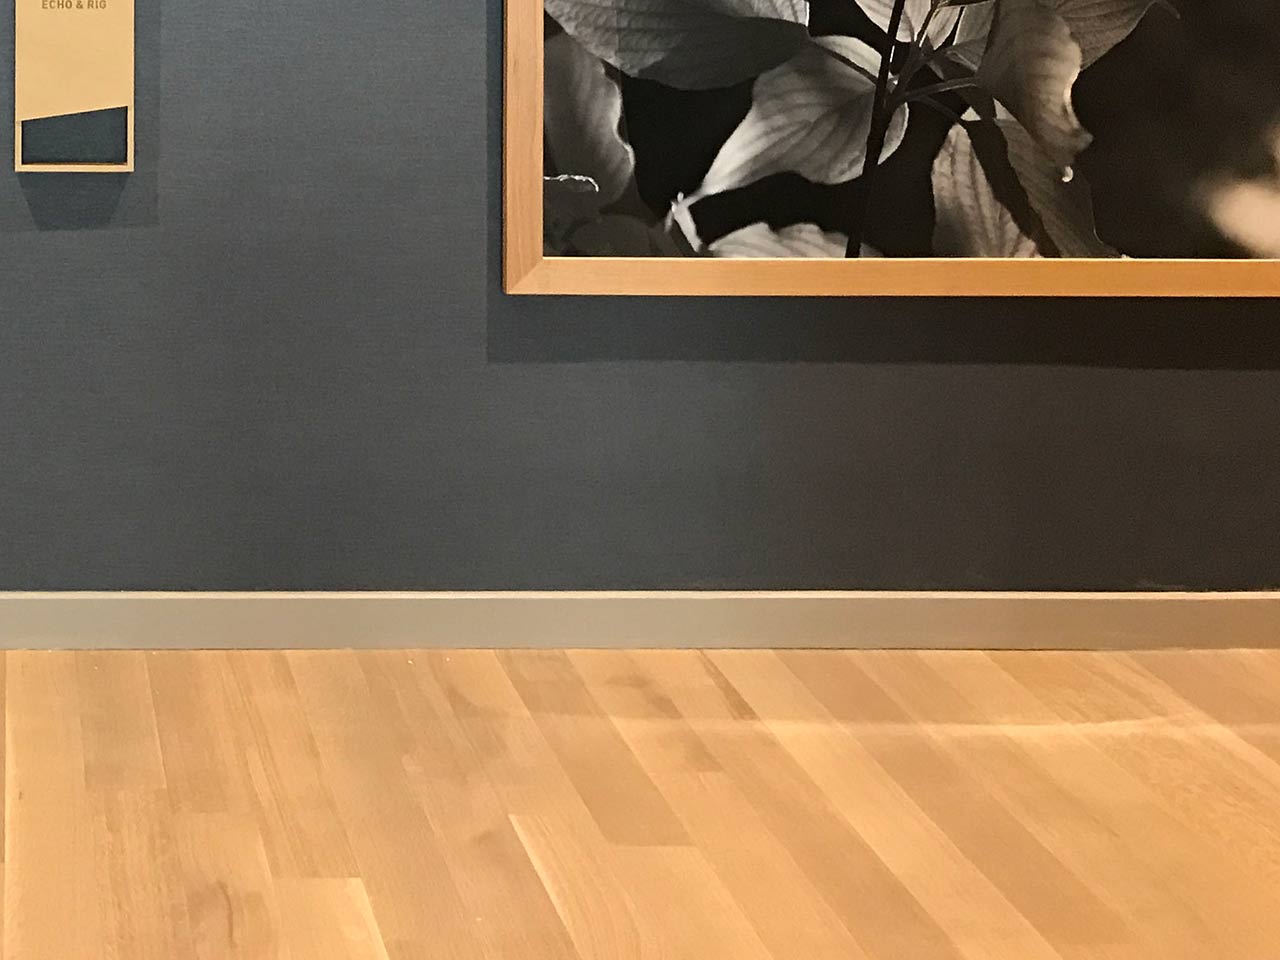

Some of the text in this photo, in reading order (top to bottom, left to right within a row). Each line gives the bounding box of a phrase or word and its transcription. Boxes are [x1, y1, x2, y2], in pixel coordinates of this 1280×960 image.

[41, 0, 107, 9] ECHO & RIG
